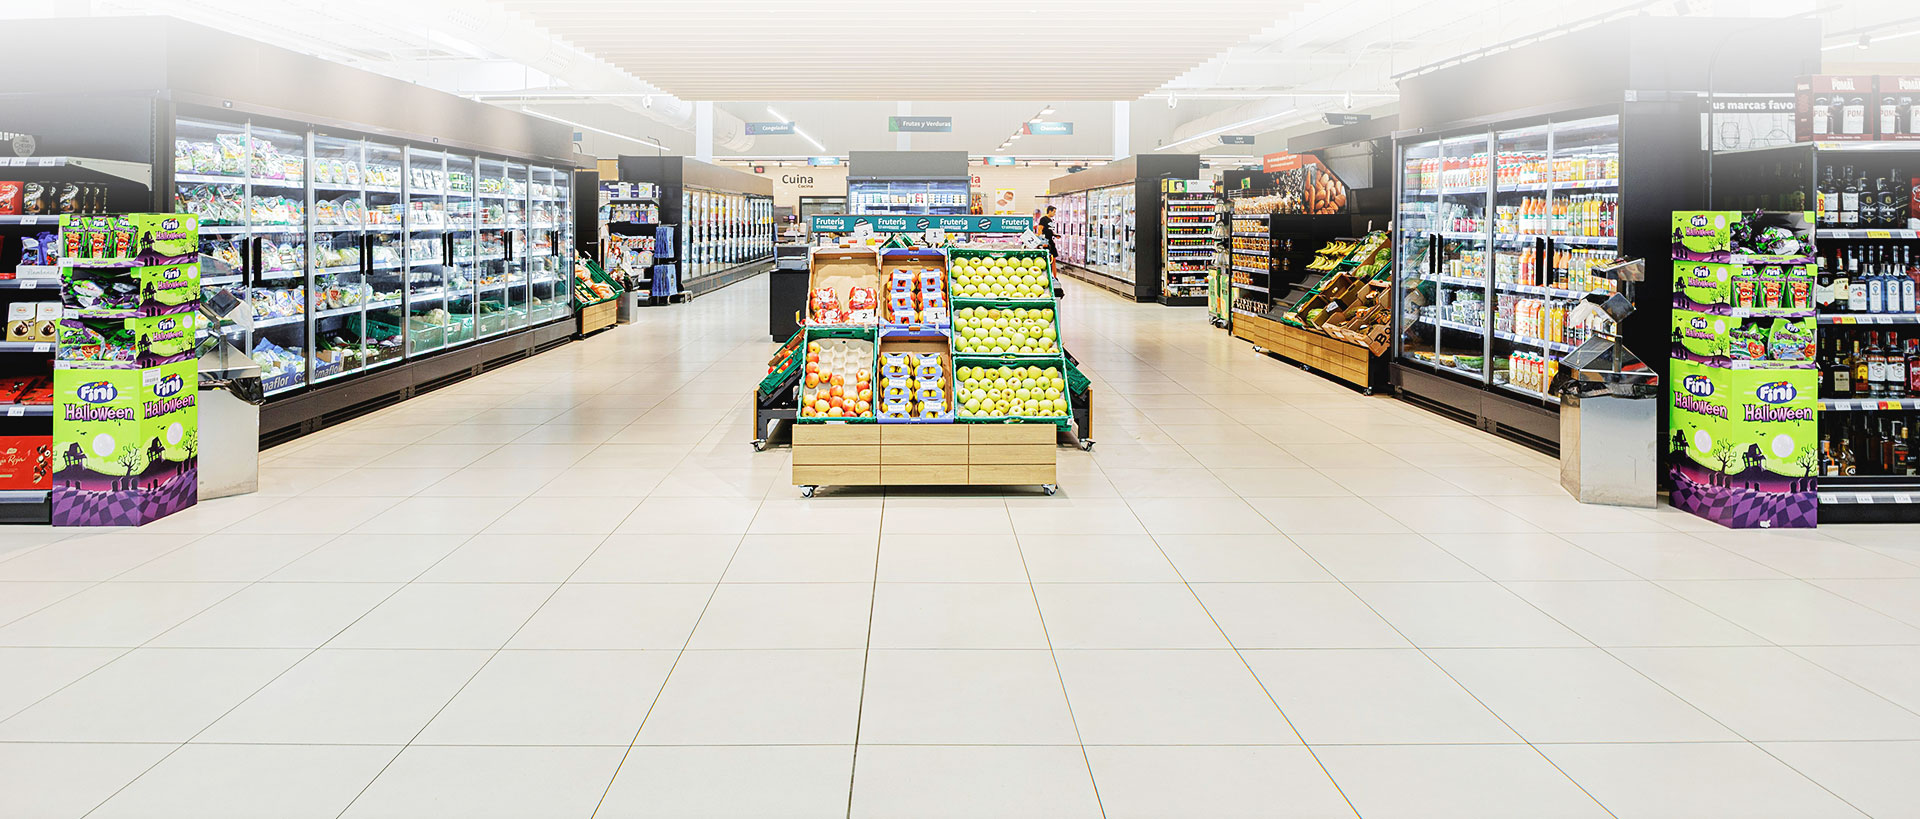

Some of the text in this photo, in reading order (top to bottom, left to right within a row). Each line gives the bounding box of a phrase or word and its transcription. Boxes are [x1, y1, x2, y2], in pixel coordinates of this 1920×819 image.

[1727, 102, 1766, 110] marcas
[1768, 100, 1795, 109] favo
[782, 174, 814, 184] Cuina
[816, 217, 844, 225] Frutería
[878, 217, 906, 225] Frutería
[940, 217, 968, 225] Frutería
[1001, 217, 1029, 225] Frutería
[79, 382, 116, 403] Fini
[156, 374, 183, 397] Fini
[1685, 374, 1713, 396] Fini
[1758, 381, 1795, 403] Fini
[64, 403, 135, 422] Halloween
[144, 393, 195, 419] Halloween
[1674, 391, 1728, 420] Halloween
[1743, 404, 1814, 423] Halloween
